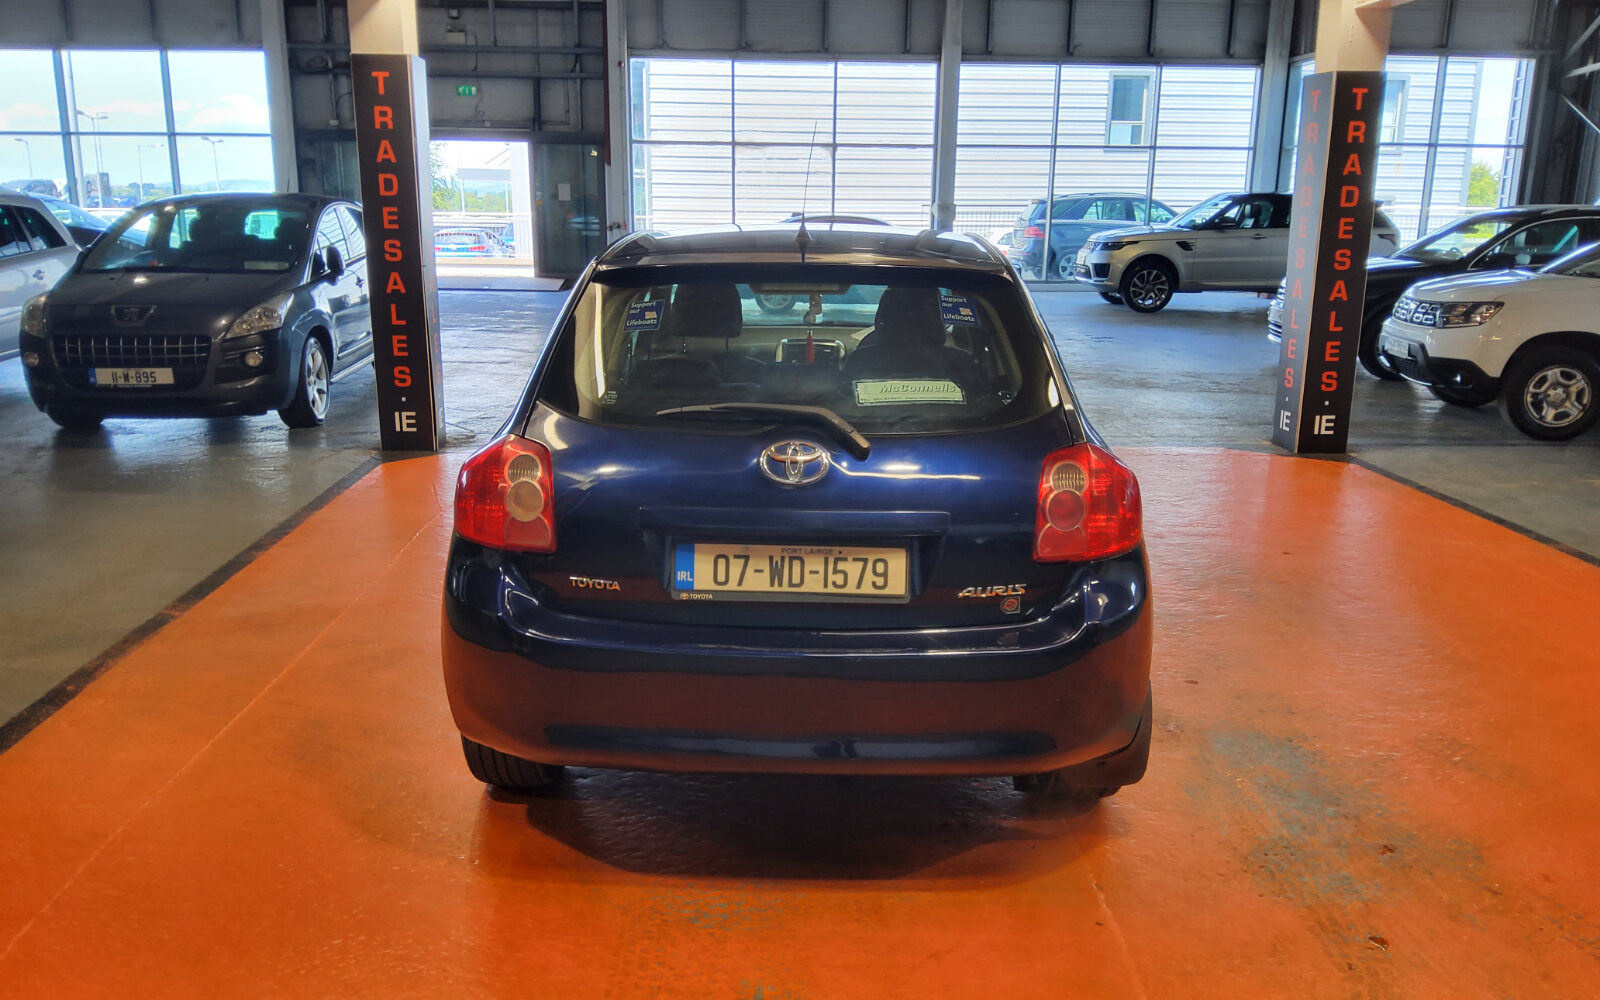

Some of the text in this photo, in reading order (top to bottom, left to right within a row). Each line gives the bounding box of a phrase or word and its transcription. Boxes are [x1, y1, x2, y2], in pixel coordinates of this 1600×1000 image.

[940, 295, 968, 304] Support
[630, 301, 657, 309] Support
[626, 318, 658, 326] Lifeboats
[943, 313, 976, 322] Lifeboats
[677, 571, 694, 582] IRL
[712, 553, 890, 591] 07-WD-1579
[569, 576, 621, 591] TOYOTA
[958, 583, 1027, 598] AURIS
